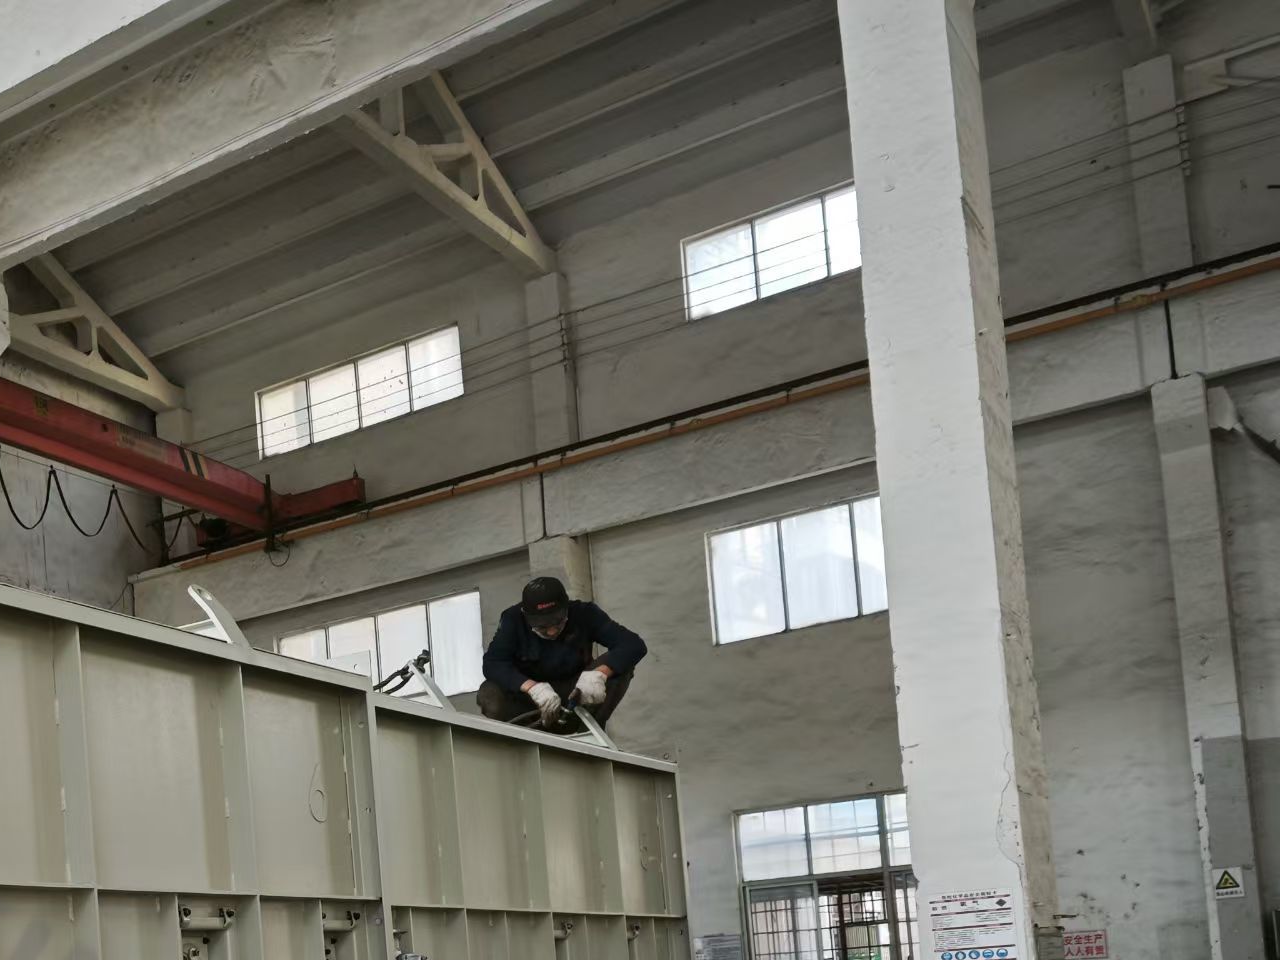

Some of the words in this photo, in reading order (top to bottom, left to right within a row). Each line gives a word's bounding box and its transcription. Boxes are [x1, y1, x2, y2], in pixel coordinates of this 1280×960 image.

[1063, 933, 1104, 945] 安全生产
[1063, 945, 1105, 957] 人人有责
